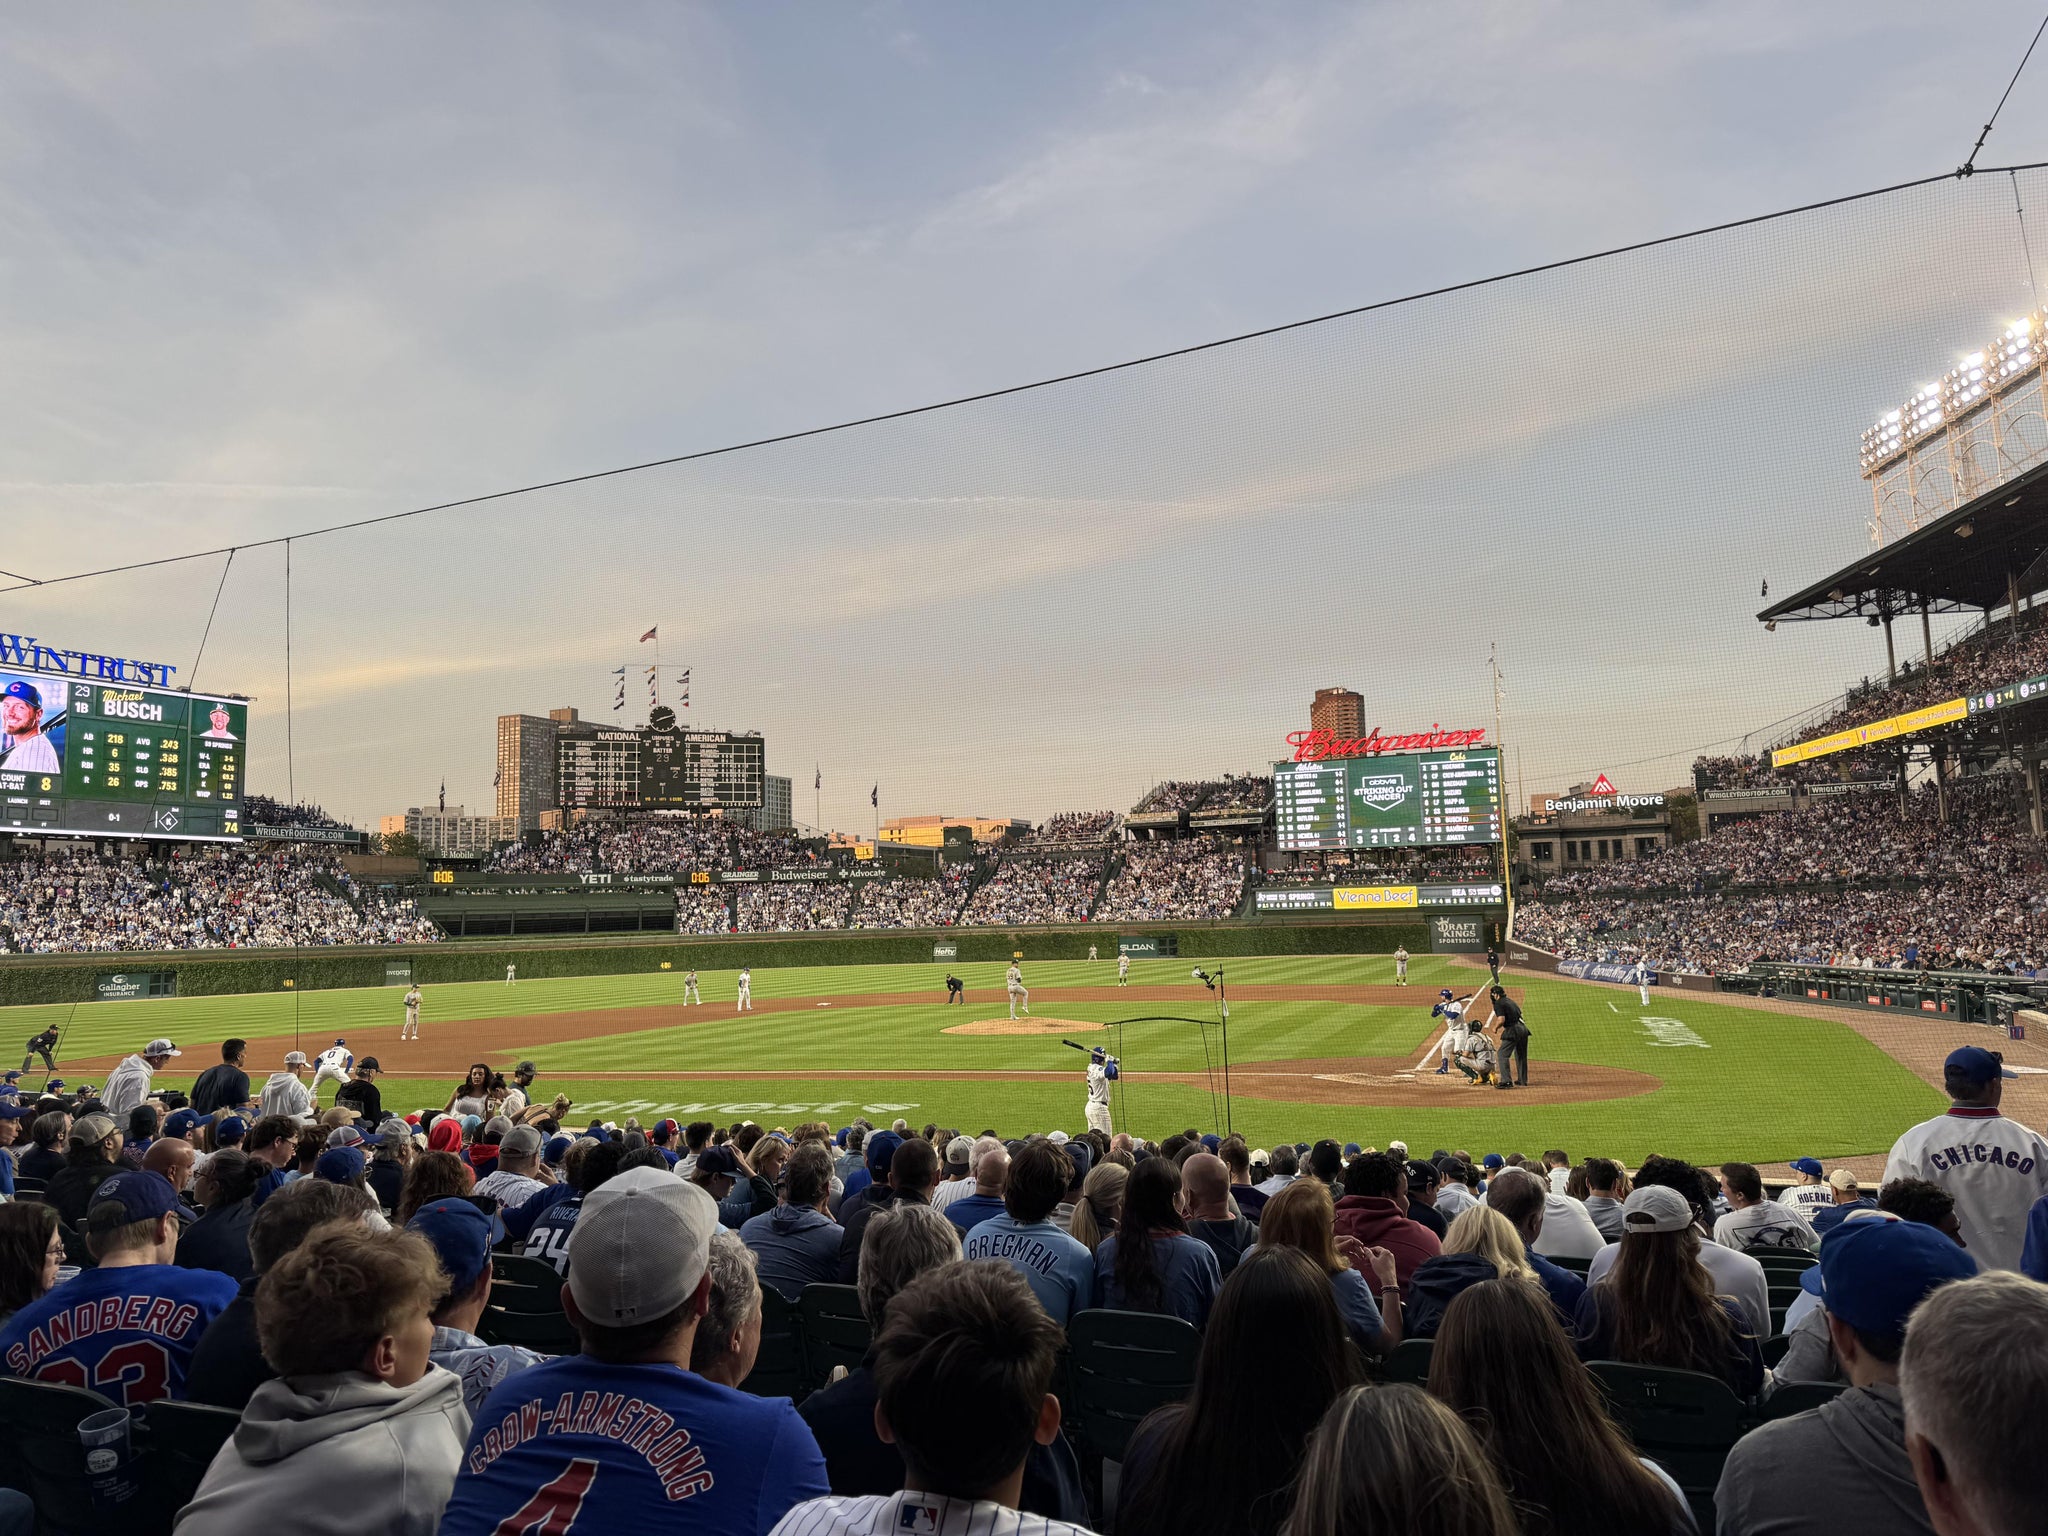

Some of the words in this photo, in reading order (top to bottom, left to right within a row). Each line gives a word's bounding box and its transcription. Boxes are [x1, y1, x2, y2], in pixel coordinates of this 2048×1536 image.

[0, 633, 177, 687] WINTRUST
[75, 685, 90, 697] 29
[2009, 689, 2014, 699] 4
[2029, 684, 2037, 694] 29
[102, 689, 145, 704] Michael
[1996, 692, 2002, 704] 3
[75, 702, 89, 714] 1B
[1978, 697, 1984, 709] 2
[104, 701, 162, 721] BUSCH
[107, 734, 124, 744] 218
[597, 732, 641, 740] NATIONAL
[685, 734, 726, 742] AMERICAN
[136, 738, 151, 746] AVG
[160, 739, 179, 750] .243
[1285, 723, 1486, 762] Budweiser
[82, 747, 94, 755] HR
[111, 748, 118, 758] 6
[136, 752, 150, 760] OBP
[160, 753, 179, 763] .368
[656, 754, 670, 762] 29
[81, 761, 94, 769] RBI
[108, 763, 120, 773] 35
[136, 766, 149, 774] SLG
[159, 767, 178, 777] .385
[647, 771, 654, 779] 2
[672, 771, 679, 779] 2
[1, 774, 26, 783] COUNT
[83, 775, 90, 784] R
[107, 777, 120, 787] 26
[41, 777, 52, 791] 8
[135, 780, 149, 788] OPS
[158, 781, 177, 791] .753
[1353, 786, 1394, 796] STRIKING
[1396, 785, 1413, 793] OUT
[1709, 789, 1787, 799] WRIGLEYROOFTOPS.COM
[1366, 793, 1401, 801] CANCER
[1545, 797, 1612, 812] Benjamin
[1616, 795, 1664, 807] Moore
[108, 813, 121, 822] 0-1
[224, 822, 238, 834] 74
[255, 826, 345, 840] WRIGLEYROOFTOPS.COM
[1356, 835, 1363, 844] 3
[1371, 835, 1378, 844] 2
[1393, 834, 1400, 843] 2
[1408, 833, 1416, 842] 4
[433, 871, 453, 883] 0:06
[579, 874, 612, 884] YETI
[630, 875, 674, 883] tastytrade
[691, 872, 710, 883] 0:06
[721, 871, 760, 879] GRAINGER
[850, 870, 886, 878] Advocate
[1336, 890, 1381, 905] Vienna
[1383, 889, 1415, 906] Beef
[1438, 923, 1477, 932] DRAFT
[1443, 930, 1476, 938] KINGS
[934, 947, 956, 956] Hefty
[98, 983, 141, 992] Gallagher
[327, 1051, 336, 1059] 0
[1930, 1144, 2035, 1175] CHICAGO
[523, 1227, 569, 1277] 24
[968, 1234, 1060, 1276] BREGMAN
[6, 1296, 199, 1377] SANDBERG
[470, 1389, 716, 1502] CROW-ARMSTRONG
